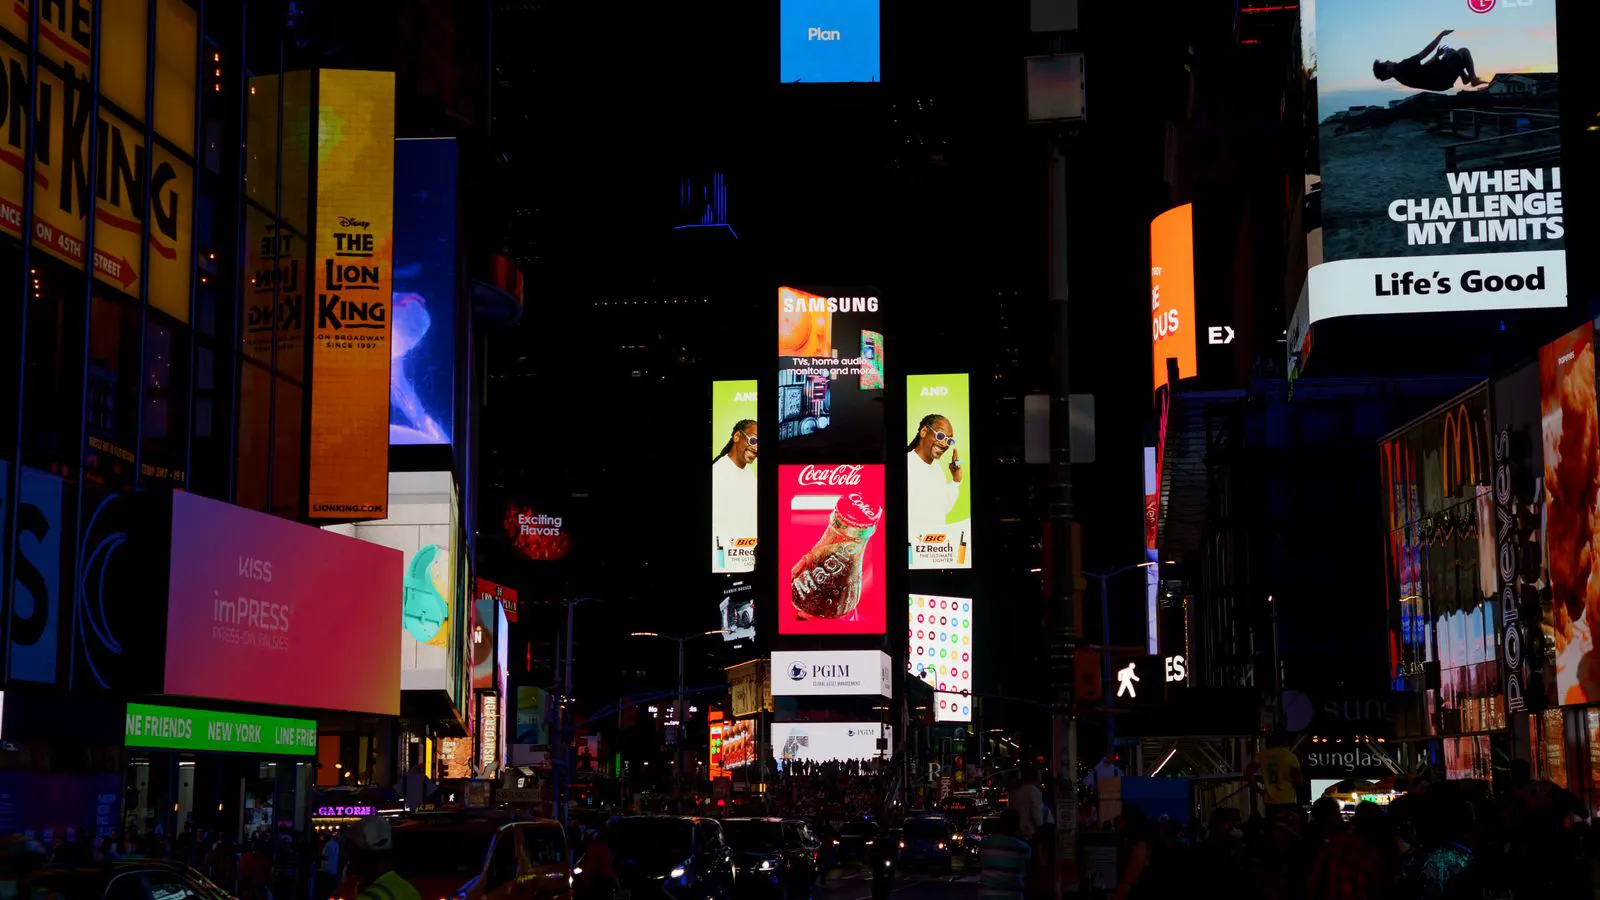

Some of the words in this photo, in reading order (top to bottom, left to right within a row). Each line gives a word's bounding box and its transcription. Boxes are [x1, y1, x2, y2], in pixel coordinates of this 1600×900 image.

[807, 27, 841, 41] Plan
[59, 60, 178, 241] KING
[1446, 168, 1543, 195] WHEN
[1551, 167, 1561, 190] I
[1388, 191, 1563, 222] CHALLENGE
[333, 233, 374, 252] THE
[1407, 221, 1456, 246] MY
[1463, 216, 1565, 243] LIMITS
[36, 222, 53, 244] ON
[57, 230, 82, 259] 45TH
[92, 252, 122, 278] STREET
[326, 259, 379, 290] LION
[1460, 266, 1546, 293] Good
[318, 294, 386, 330] KING
[783, 297, 879, 313] SAMSUNG
[812, 357, 839, 366] home
[830, 367, 849, 376] and
[312, 503, 383, 513] LIONKING.COM
[849, 492, 878, 519] Coke
[518, 514, 562, 528] Exciting
[520, 525, 560, 537] Flavors
[927, 543, 954, 552] Reach
[238, 555, 273, 582] KISS
[812, 664, 850, 678] PGIM
[144, 715, 193, 739] FRIENDS
[207, 720, 235, 741] NEW
[235, 722, 261, 743] YORK
[275, 726, 294, 745] LINE
